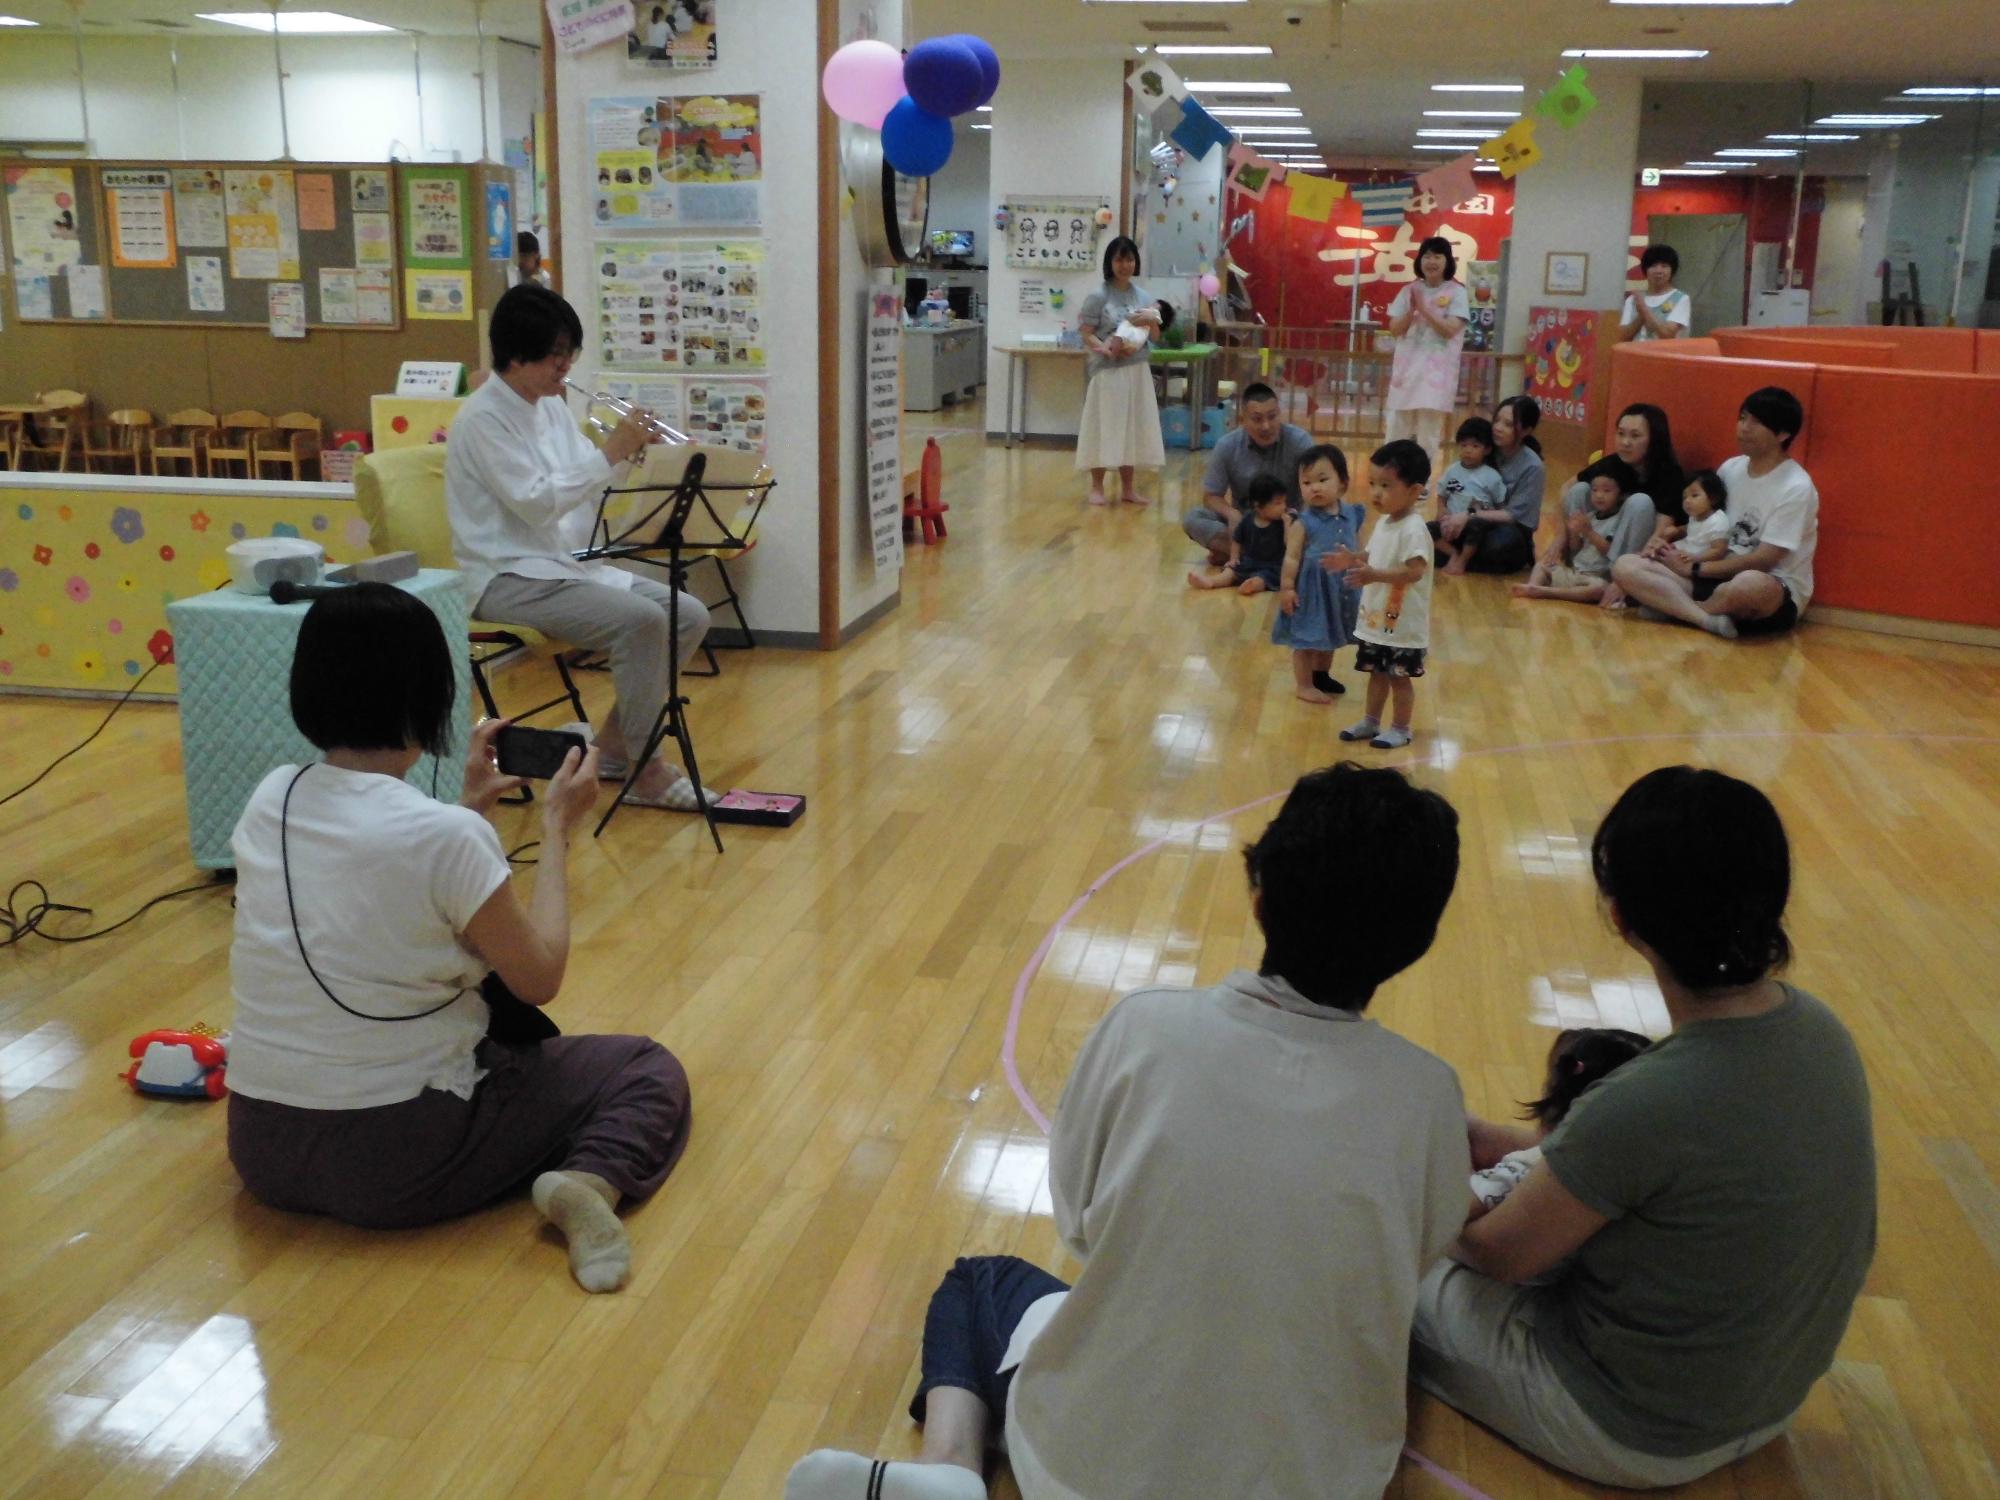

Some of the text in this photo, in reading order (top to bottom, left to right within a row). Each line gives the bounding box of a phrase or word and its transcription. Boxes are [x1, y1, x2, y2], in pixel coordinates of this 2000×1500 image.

[1016, 248, 1088, 261] こどものくに
